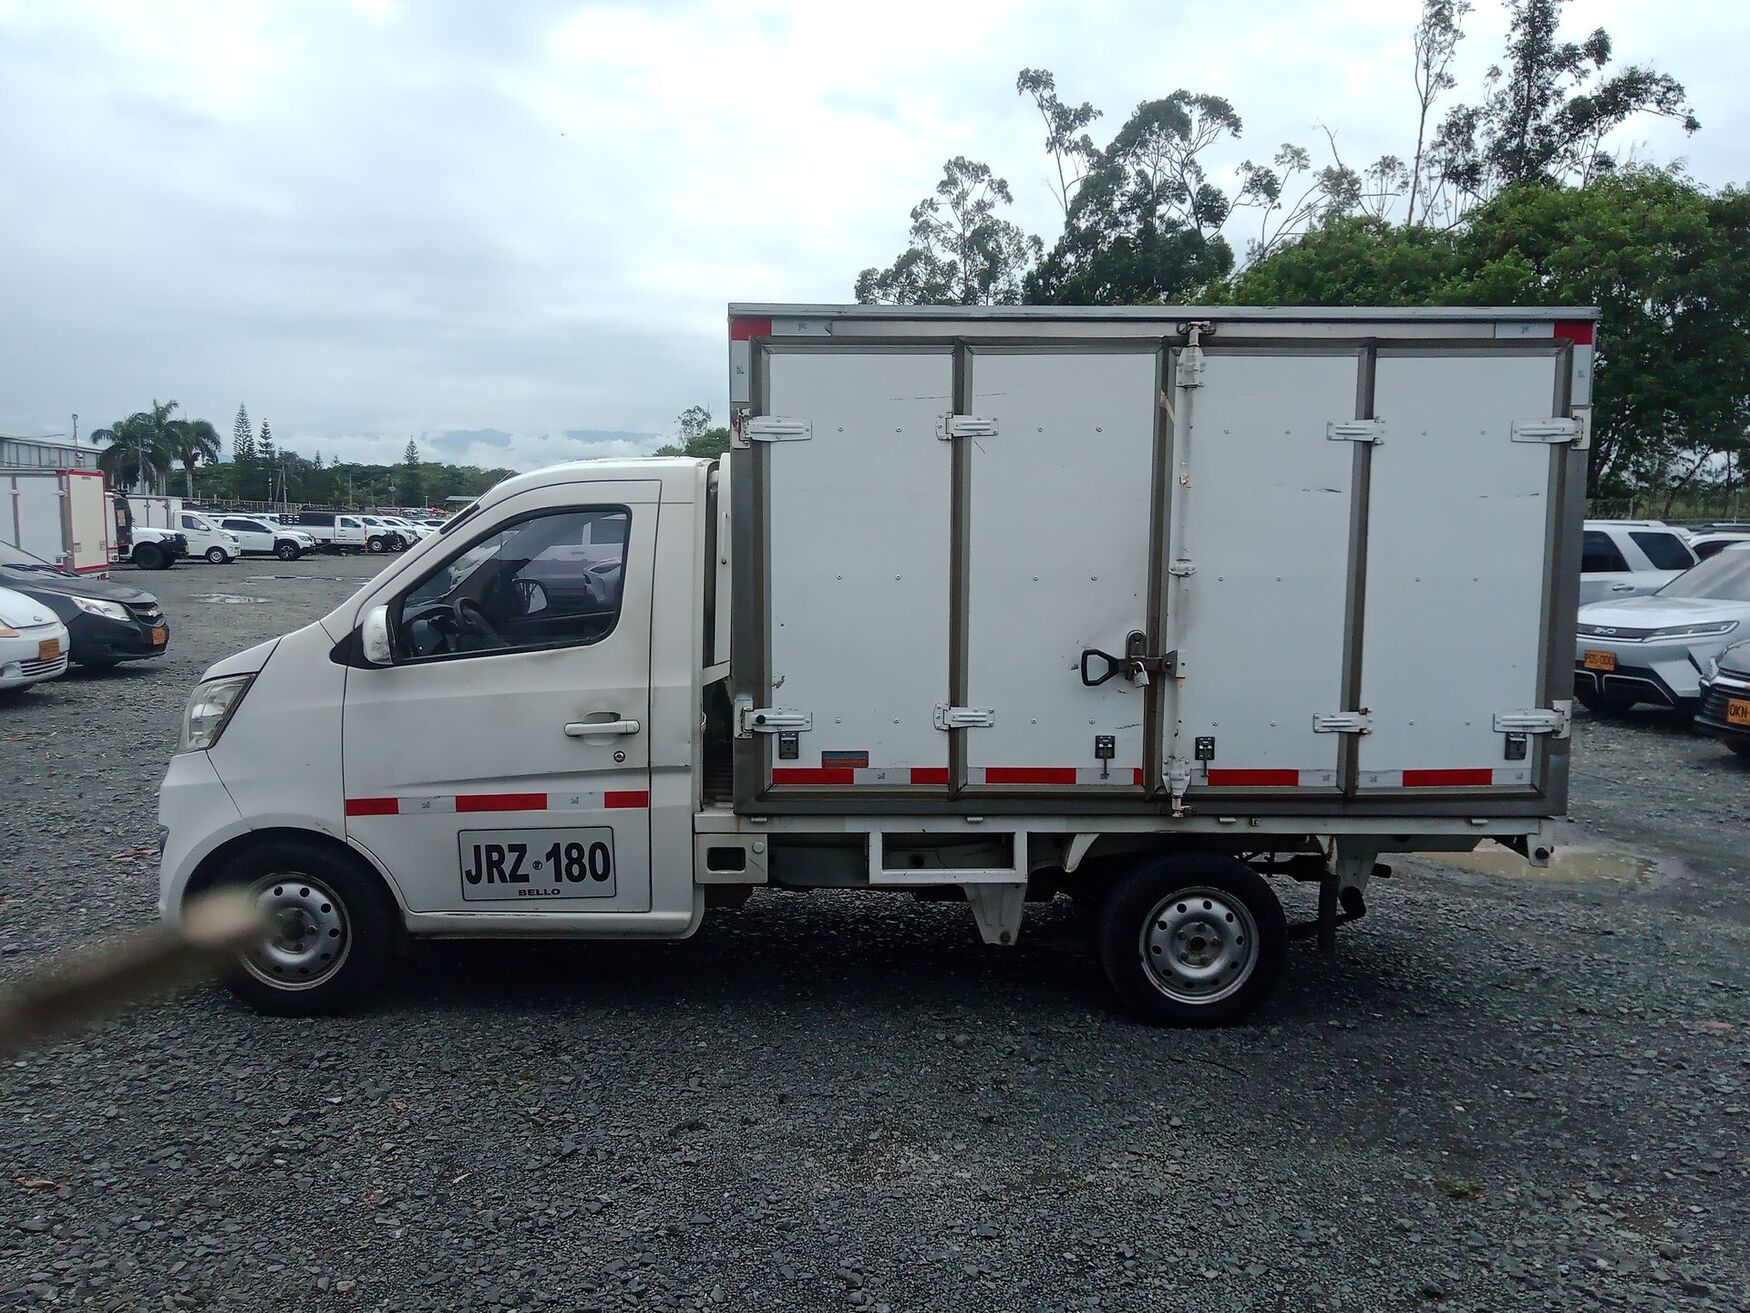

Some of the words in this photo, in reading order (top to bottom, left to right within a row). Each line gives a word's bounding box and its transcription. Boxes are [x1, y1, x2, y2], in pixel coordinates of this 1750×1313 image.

[464, 843, 530, 885] JRZ
[545, 841, 611, 883] 180
[518, 888, 561, 896] BELLO
